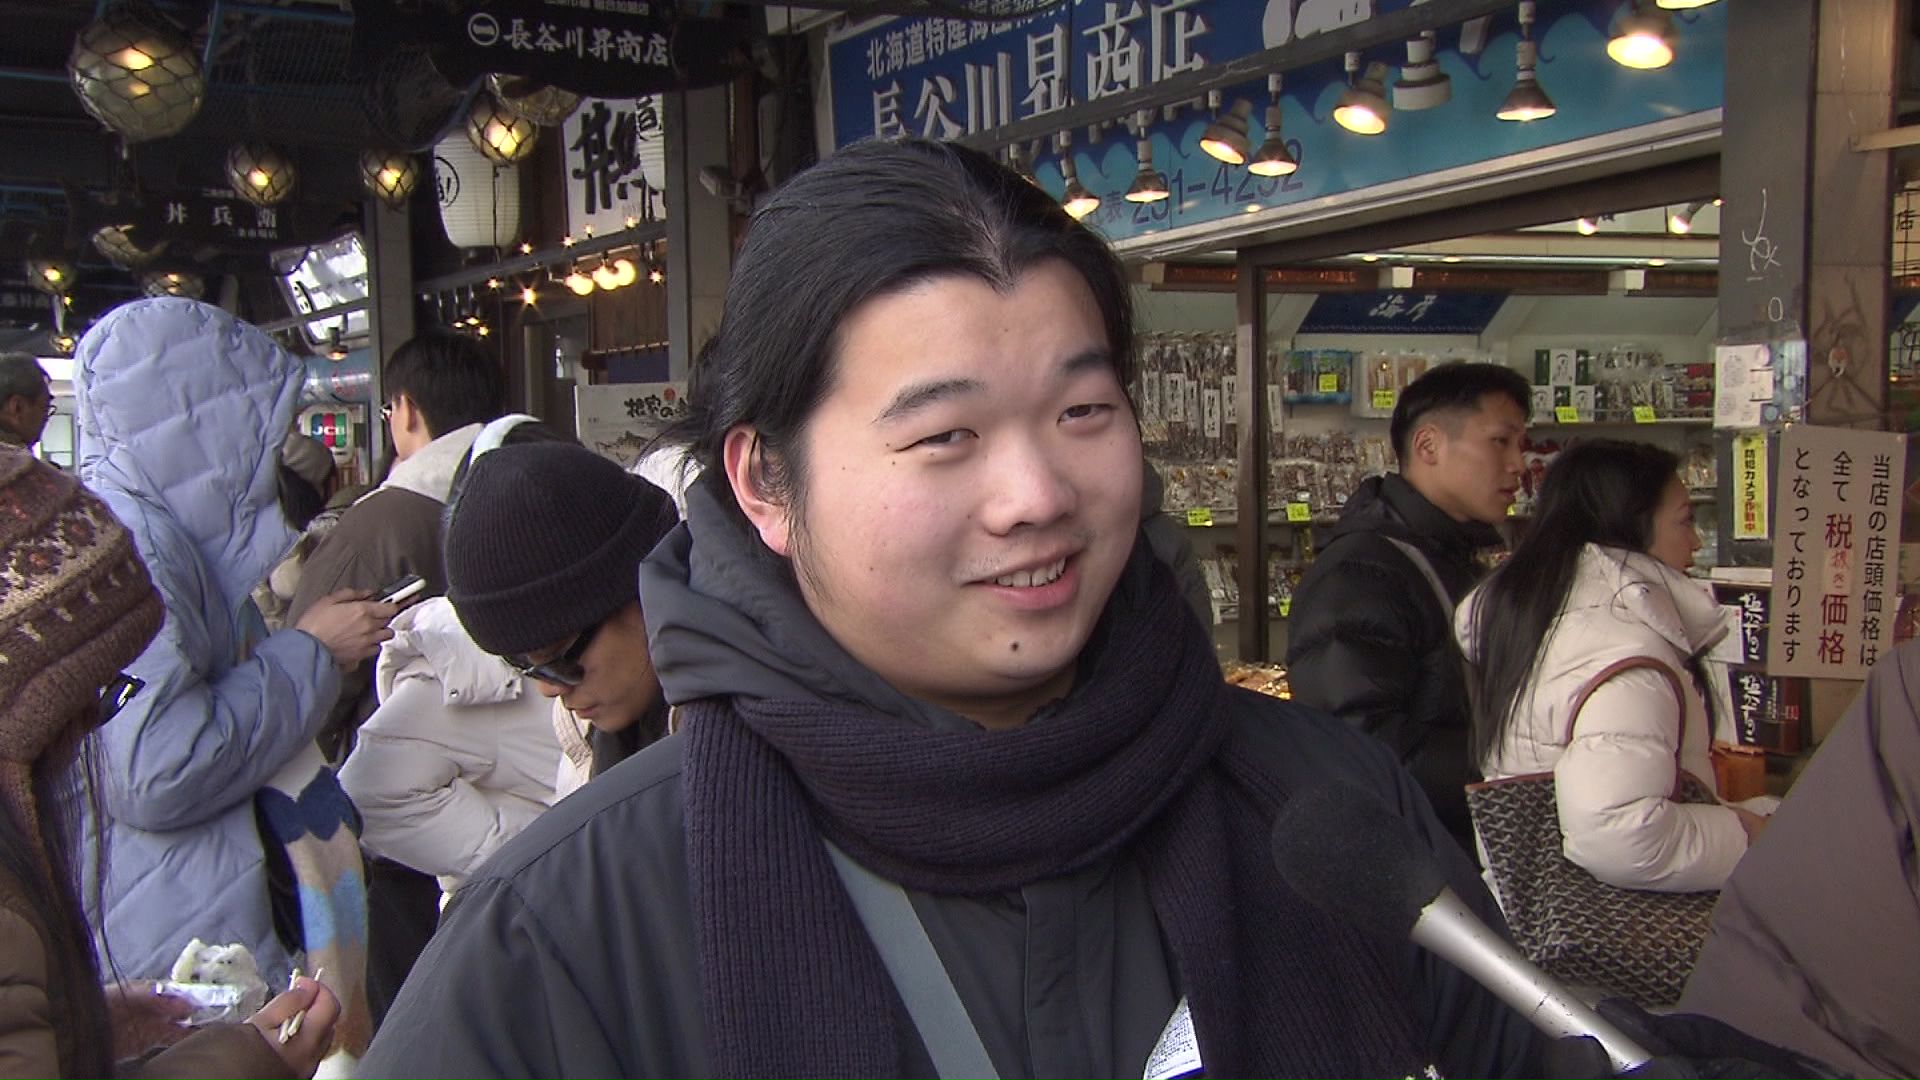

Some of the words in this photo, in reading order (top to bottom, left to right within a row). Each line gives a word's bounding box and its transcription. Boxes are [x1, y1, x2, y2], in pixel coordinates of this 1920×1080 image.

[503, 19, 668, 67] 長谷川昇商店
[1783, 447, 1812, 663] となっております
[1859, 453, 1891, 667] 当店の店頭価格は
